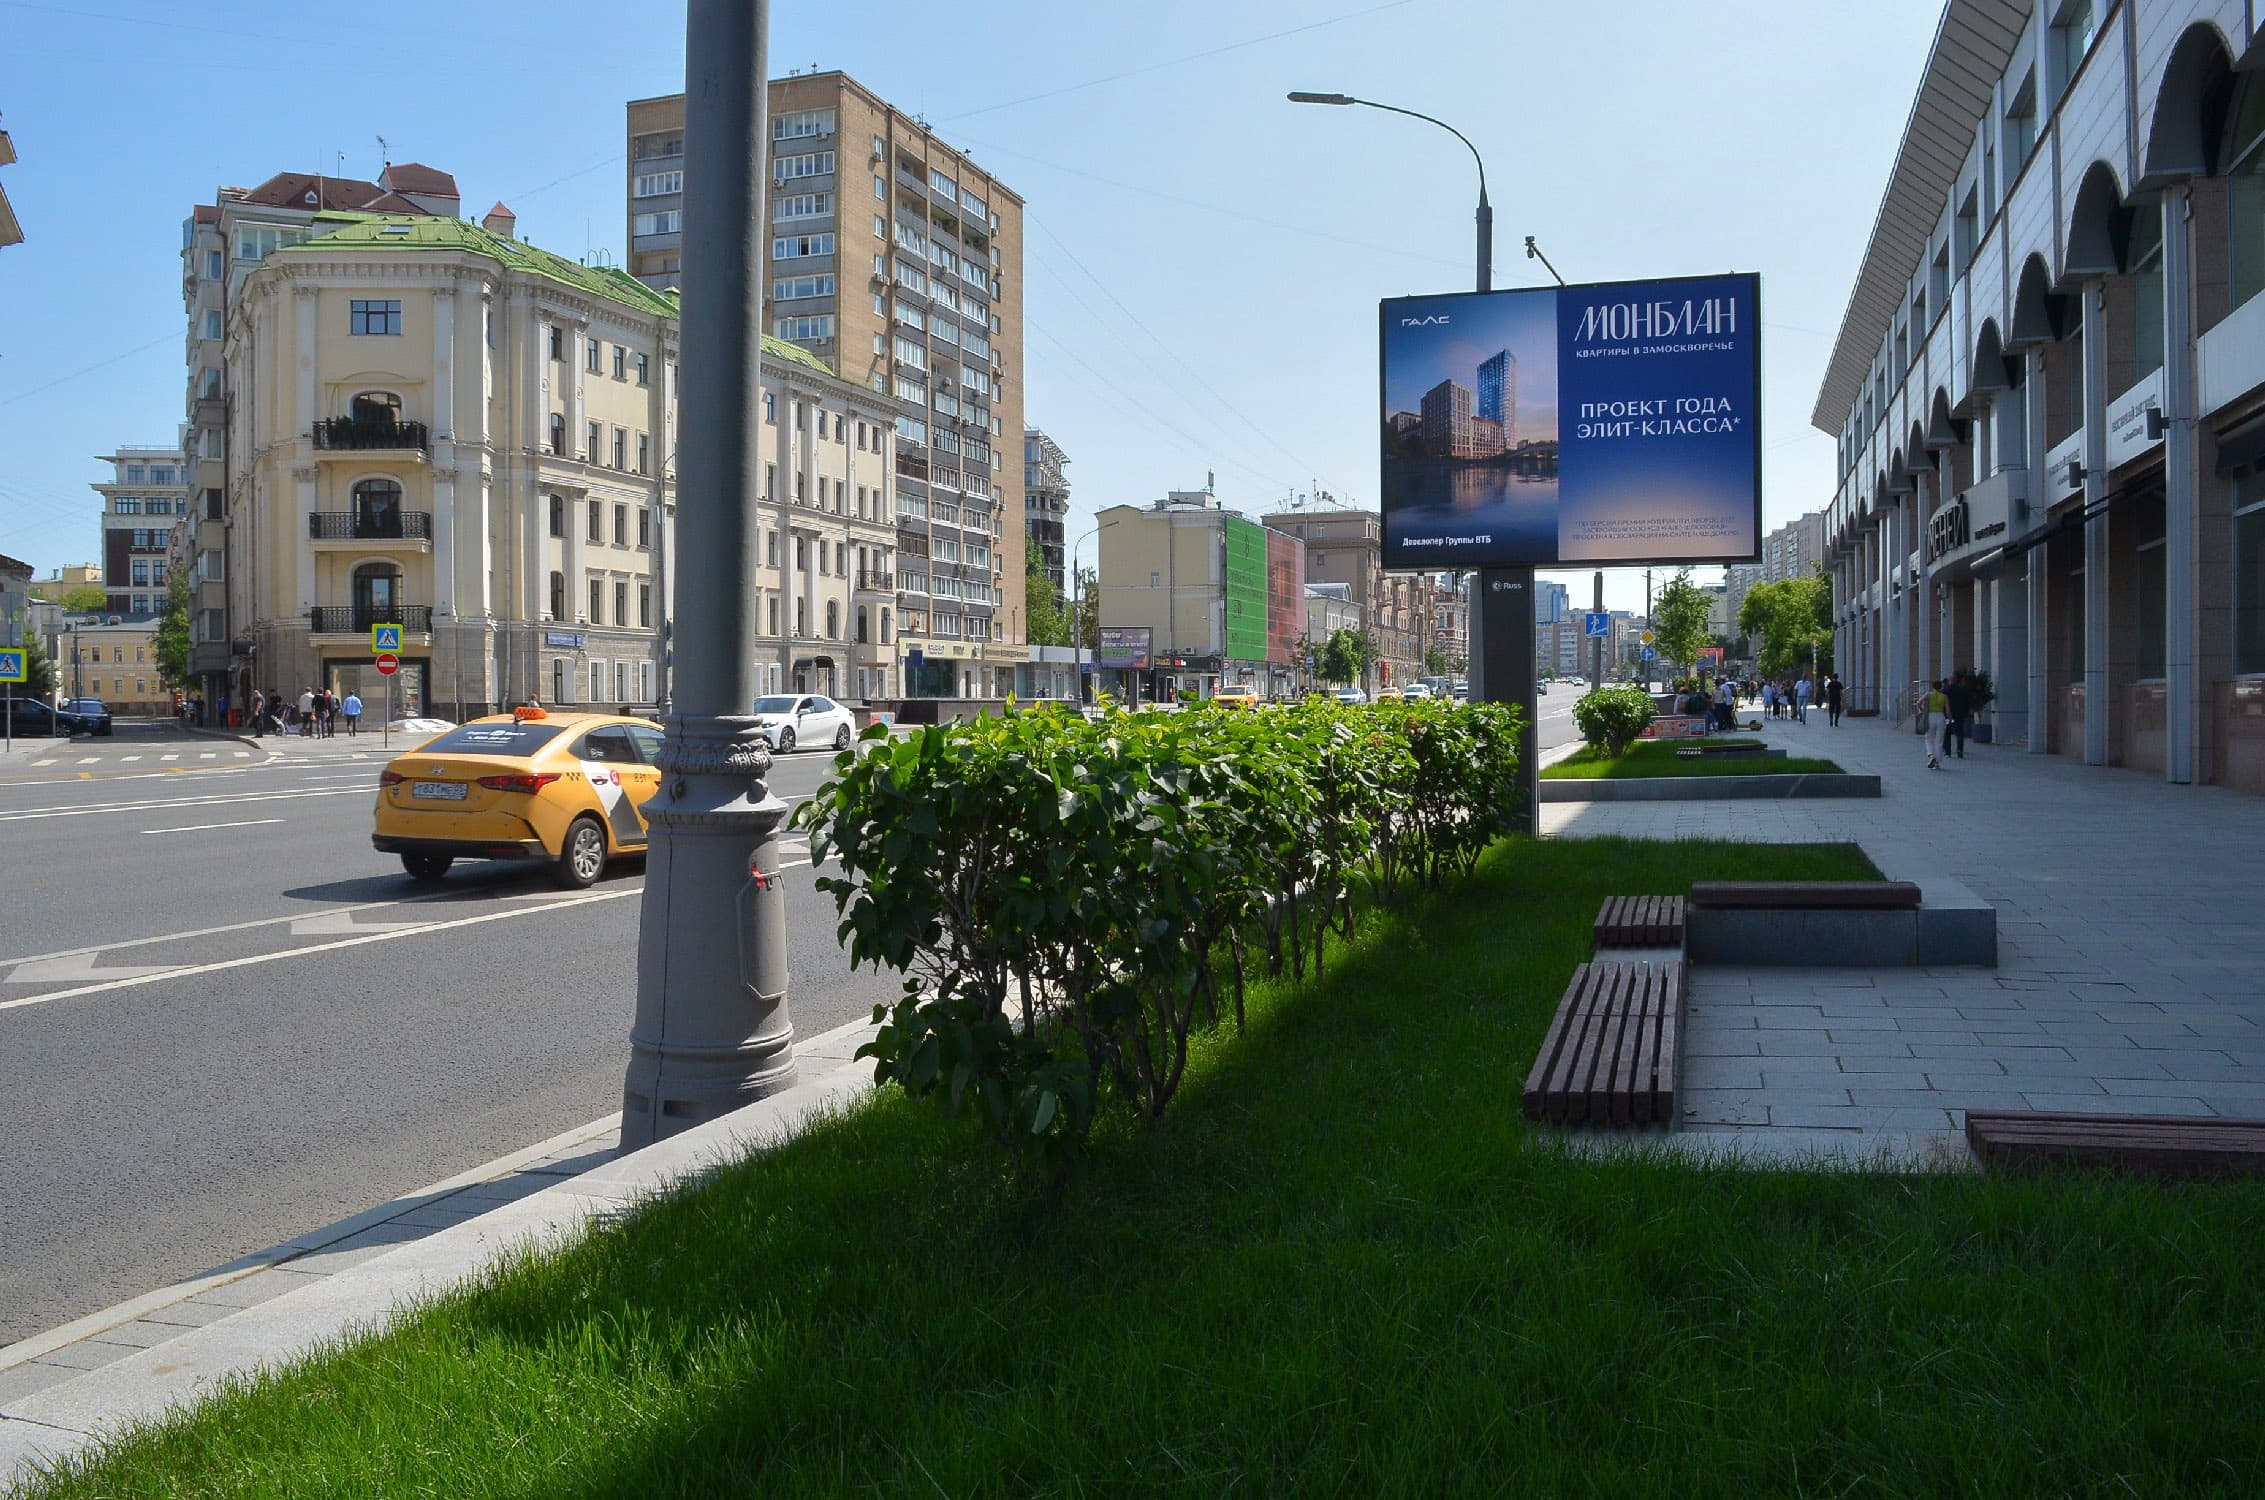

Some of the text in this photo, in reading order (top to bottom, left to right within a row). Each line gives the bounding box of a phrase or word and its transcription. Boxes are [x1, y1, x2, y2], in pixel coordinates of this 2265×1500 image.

[1401, 315, 1450, 327] ГАЛС
[1574, 297, 1735, 342] МОНБЛАН
[1576, 341, 1735, 358] КВАРТИРЫ В ЗАМОСКВОРЕЧЬЕ
[1580, 396, 1732, 419] ПРОЕКТ ГОДА
[1402, 535, 1492, 547] Девелопер Группы ВТБ
